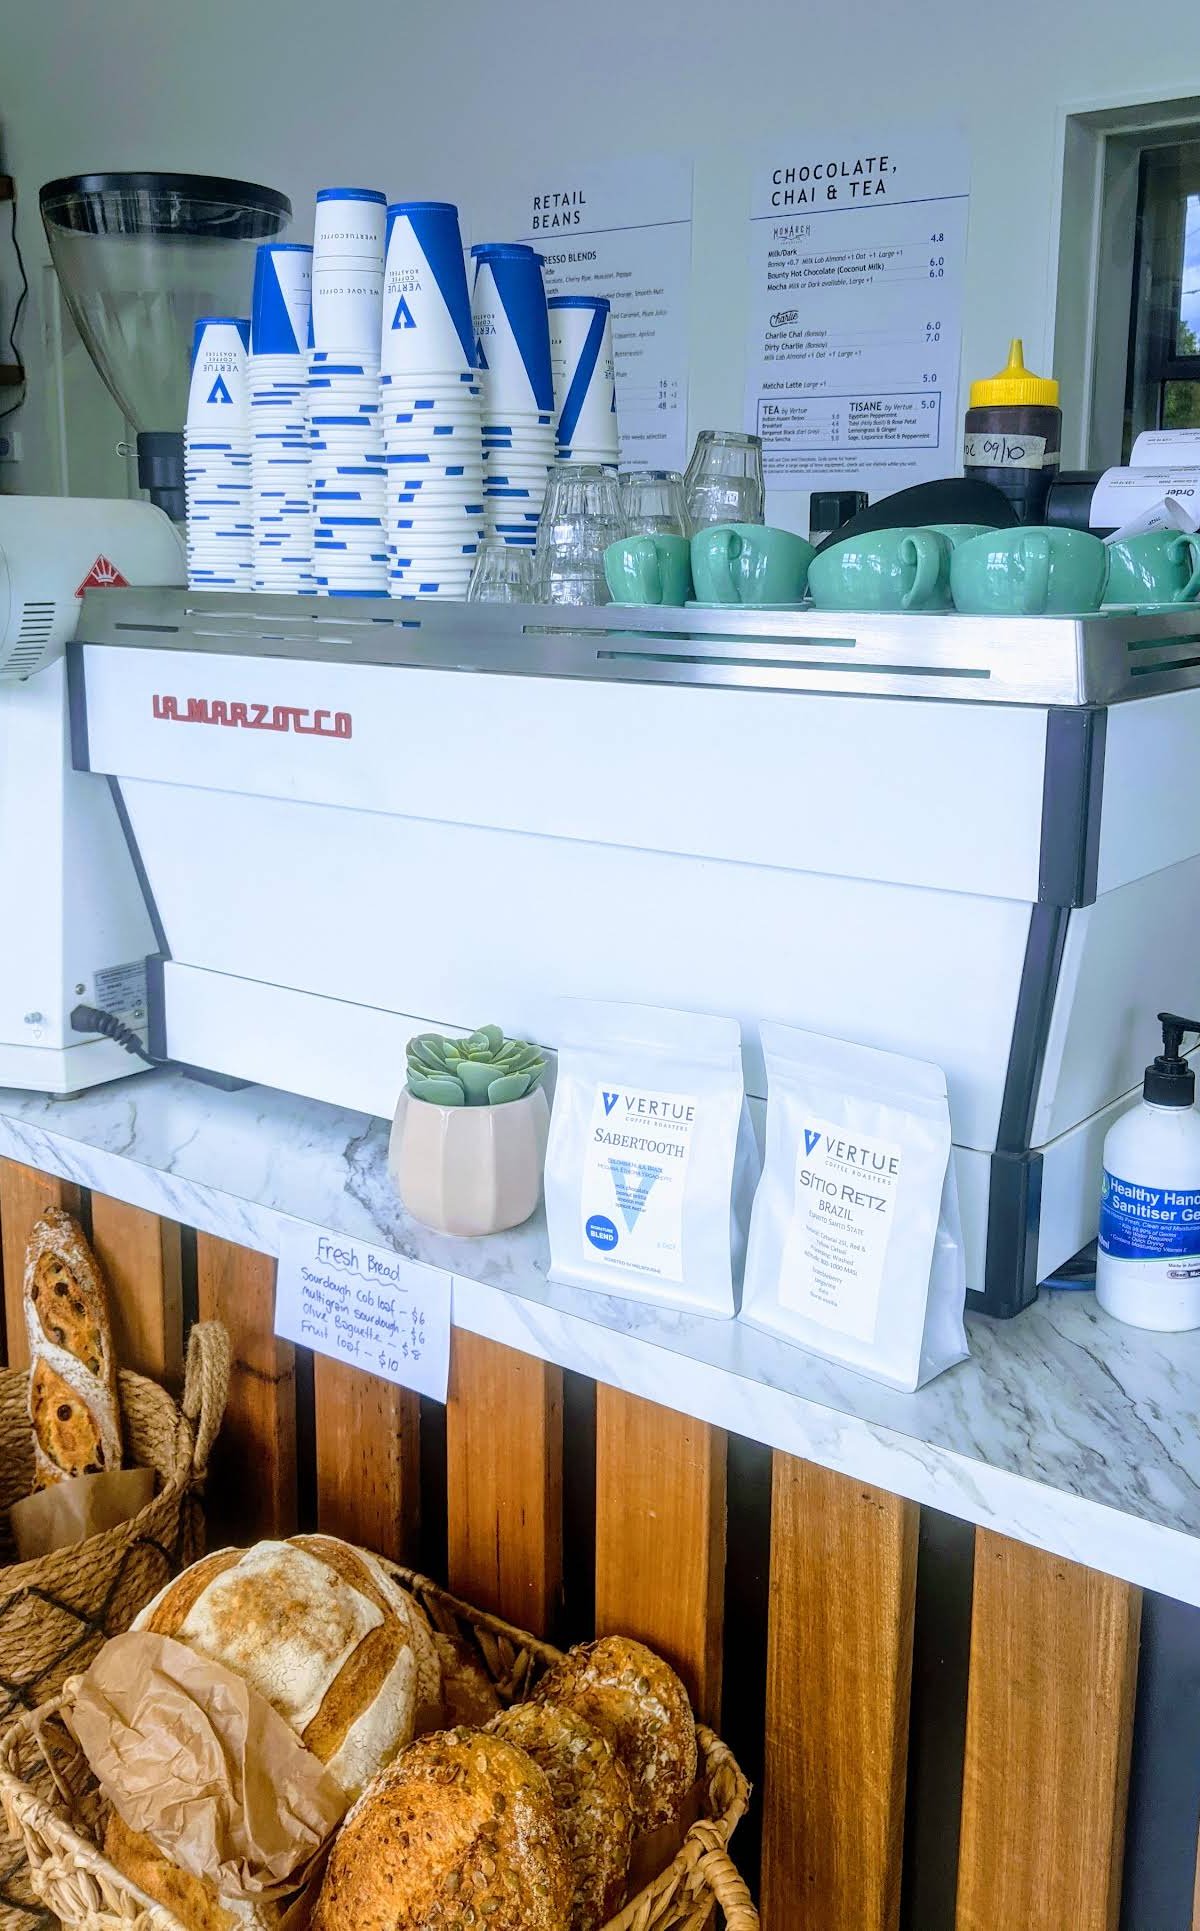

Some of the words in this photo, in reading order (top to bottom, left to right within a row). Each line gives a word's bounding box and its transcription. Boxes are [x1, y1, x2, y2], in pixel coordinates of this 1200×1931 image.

[772, 156, 897, 185] CHOCOLATE,
[533, 191, 586, 211] RETAIL
[771, 187, 815, 206] CHAI
[827, 185, 837, 200] &
[849, 179, 886, 197] TEA
[532, 211, 581, 230] BEANS
[768, 248, 798, 259] Milk/Dark
[930, 233, 944, 243] 4.8
[878, 250, 895, 259] Large
[544, 254, 567, 265] RESSO
[568, 250, 597, 263] BLENDS
[767, 271, 789, 280] Bounty
[790, 269, 802, 278] Hot
[803, 267, 836, 277] Chocolate
[837, 265, 867, 275] (Coconut
[867, 264, 884, 272] Milk)
[929, 257, 944, 267] 6.0
[388, 283, 422, 293] VERTUE
[767, 283, 787, 292] Mocha
[807, 280, 820, 288] Dark
[849, 277, 865, 286] Large
[929, 268, 944, 278] 6.0
[473, 327, 497, 336] VERT
[765, 330, 788, 340] Charlie
[788, 330, 803, 339] Chai
[926, 321, 941, 331] 6.0
[764, 343, 780, 352] Dirty
[781, 342, 804, 351] Charlie
[925, 333, 940, 342] 7.0
[837, 350, 854, 359] Large
[202, 364, 239, 373] VERTUE
[659, 380, 668, 388] 16
[762, 381, 784, 390] Matcha
[785, 381, 803, 389] Latte
[922, 374, 937, 383] 5.0
[658, 391, 667, 399] 31
[763, 406, 780, 415] TEA
[781, 407, 788, 415] by
[789, 406, 808, 414] Vertue
[849, 402, 883, 412] TISANE
[884, 404, 892, 412] by
[893, 403, 913, 411] Vertue
[921, 400, 935, 409] 5.0
[848, 427, 875, 435] Lemongrass
[984, 437, 1025, 463] 09/10
[1165, 488, 1195, 497] Order
[152, 694, 179, 721] LA
[624, 1095, 696, 1121] VERTUE
[624, 1116, 651, 1127] COFFEE
[653, 1121, 689, 1133] ROASTERS
[593, 1127, 685, 1158] SABERTOOTH
[826, 1135, 900, 1176] VERTUE
[824, 1160, 848, 1174] COFFEE
[851, 1169, 892, 1186] ROASTERS
[840, 1184, 887, 1212] RETZ
[1110, 1177, 1160, 1206] Healthy
[818, 1199, 854, 1221] BRAZIL
[1112, 1195, 1176, 1221] Sanitiser
[1181, 1209, 1200, 1221] Ge
[846, 1224, 865, 1236] STATE
[1124, 1217, 1141, 1226] Fresh,
[1142, 1222, 1159, 1230] Clean
[590, 1230, 614, 1242] BLEND
[1131, 1236, 1146, 1244] Quick
[1146, 1239, 1165, 1248] Drying
[1132, 1231, 1148, 1239] Water
[1148, 1234, 1173, 1243] Required
[318, 1237, 359, 1271] Fresh
[367, 1254, 400, 1282] Bread
[832, 1254, 854, 1266] Washed
[300, 1266, 351, 1303] Sourdough
[356, 1289, 375, 1306] Cob
[377, 1295, 396, 1317] loaf
[411, 1306, 425, 1326] $6
[302, 1286, 349, 1315] multigrain
[353, 1309, 399, 1338] sourdough
[410, 1327, 425, 1346] $6
[302, 1303, 327, 1321] Olive
[334, 1316, 380, 1342] Baguette
[401, 1341, 421, 1361] $8
[300, 1320, 328, 1340] Fruit
[336, 1334, 360, 1358] loaf
[378, 1350, 398, 1373] $10
